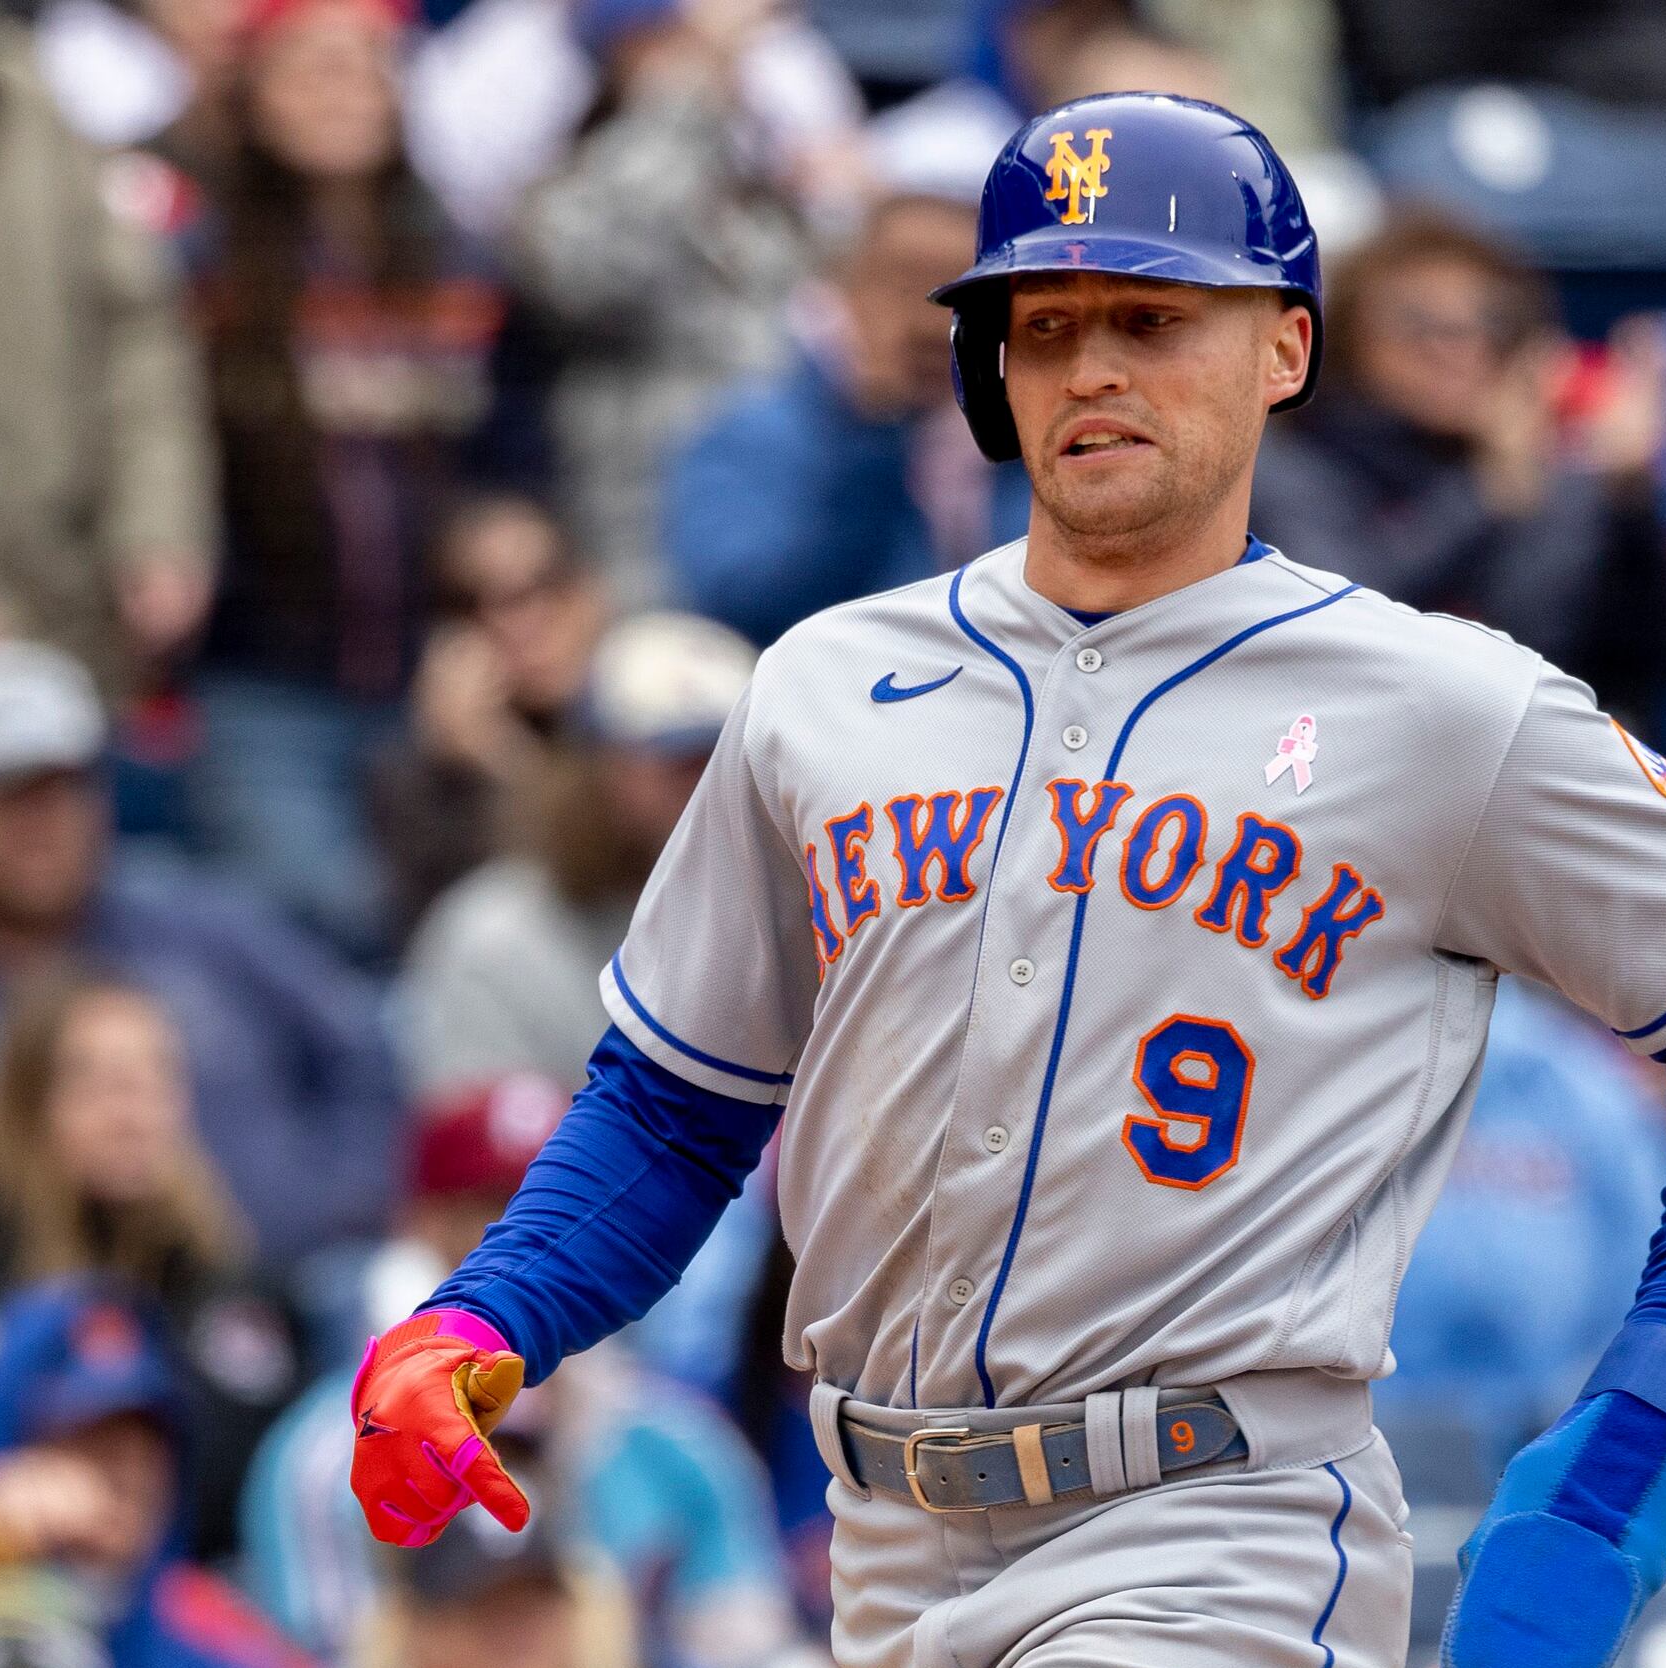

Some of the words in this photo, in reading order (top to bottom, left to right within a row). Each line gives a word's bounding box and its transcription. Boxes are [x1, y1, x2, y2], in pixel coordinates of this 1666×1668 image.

[1046, 778, 1386, 1000] YORK
[1121, 1013, 1256, 1191] 9
[1170, 1420, 1196, 1453] 9
